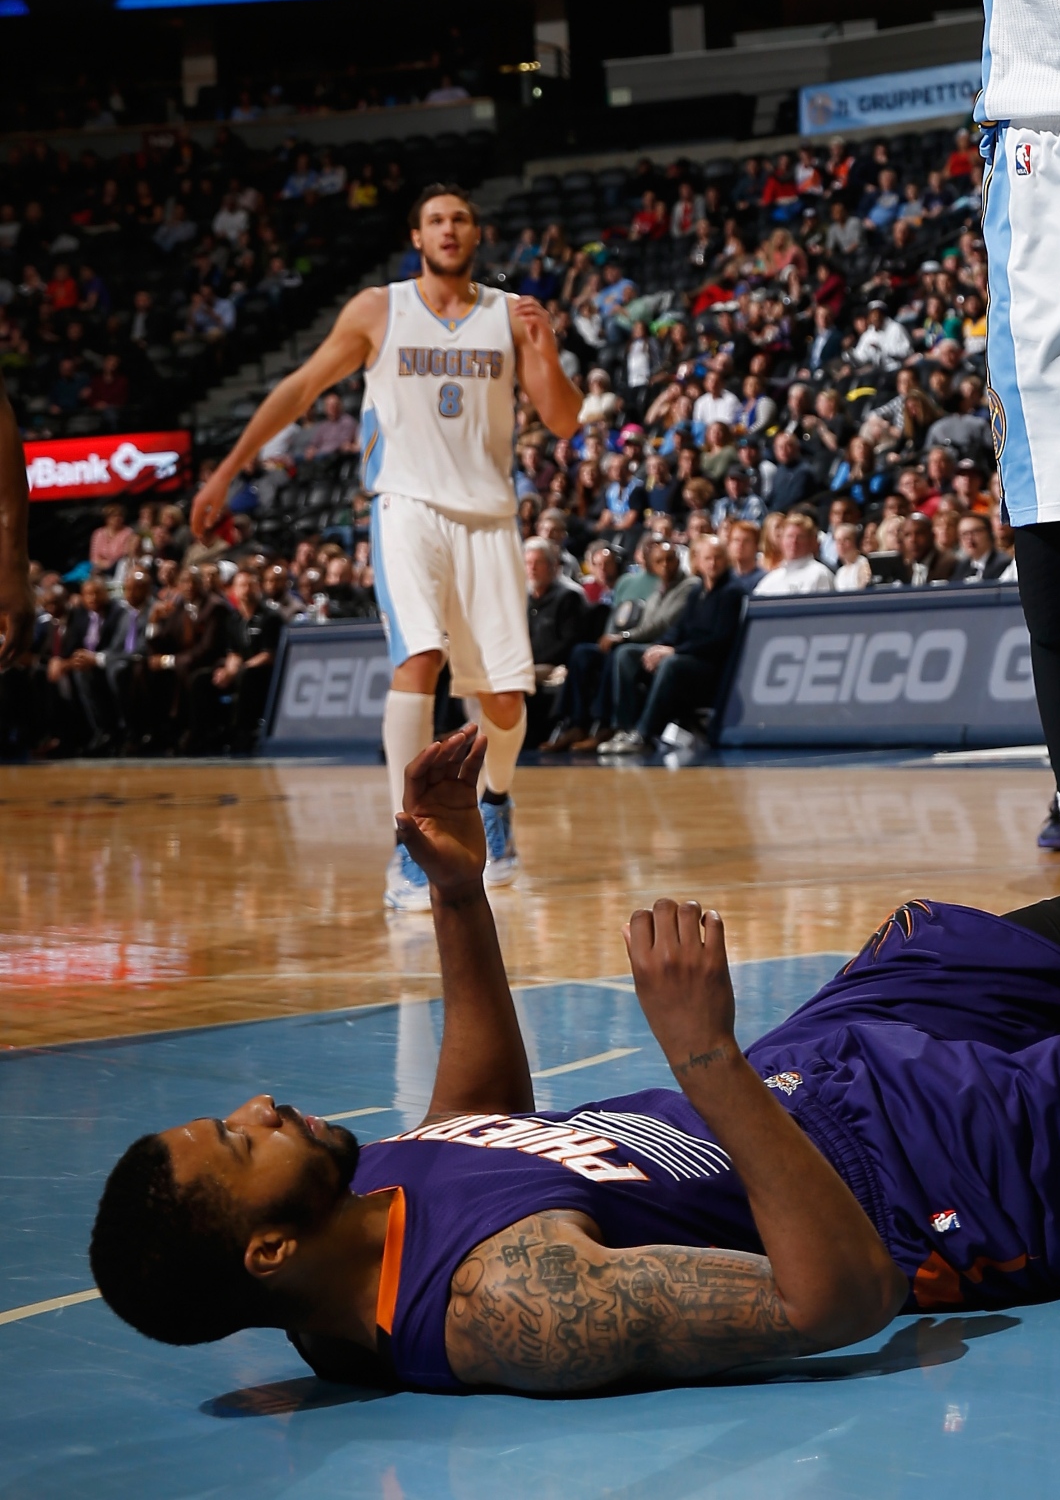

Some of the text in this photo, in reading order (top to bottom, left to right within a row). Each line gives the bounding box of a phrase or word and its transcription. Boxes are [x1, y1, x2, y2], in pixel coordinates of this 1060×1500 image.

[398, 346, 504, 378] NUGGETS
[438, 381, 463, 418] 8
[283, 656, 393, 717] GEIC
[752, 629, 967, 704] GEICO
